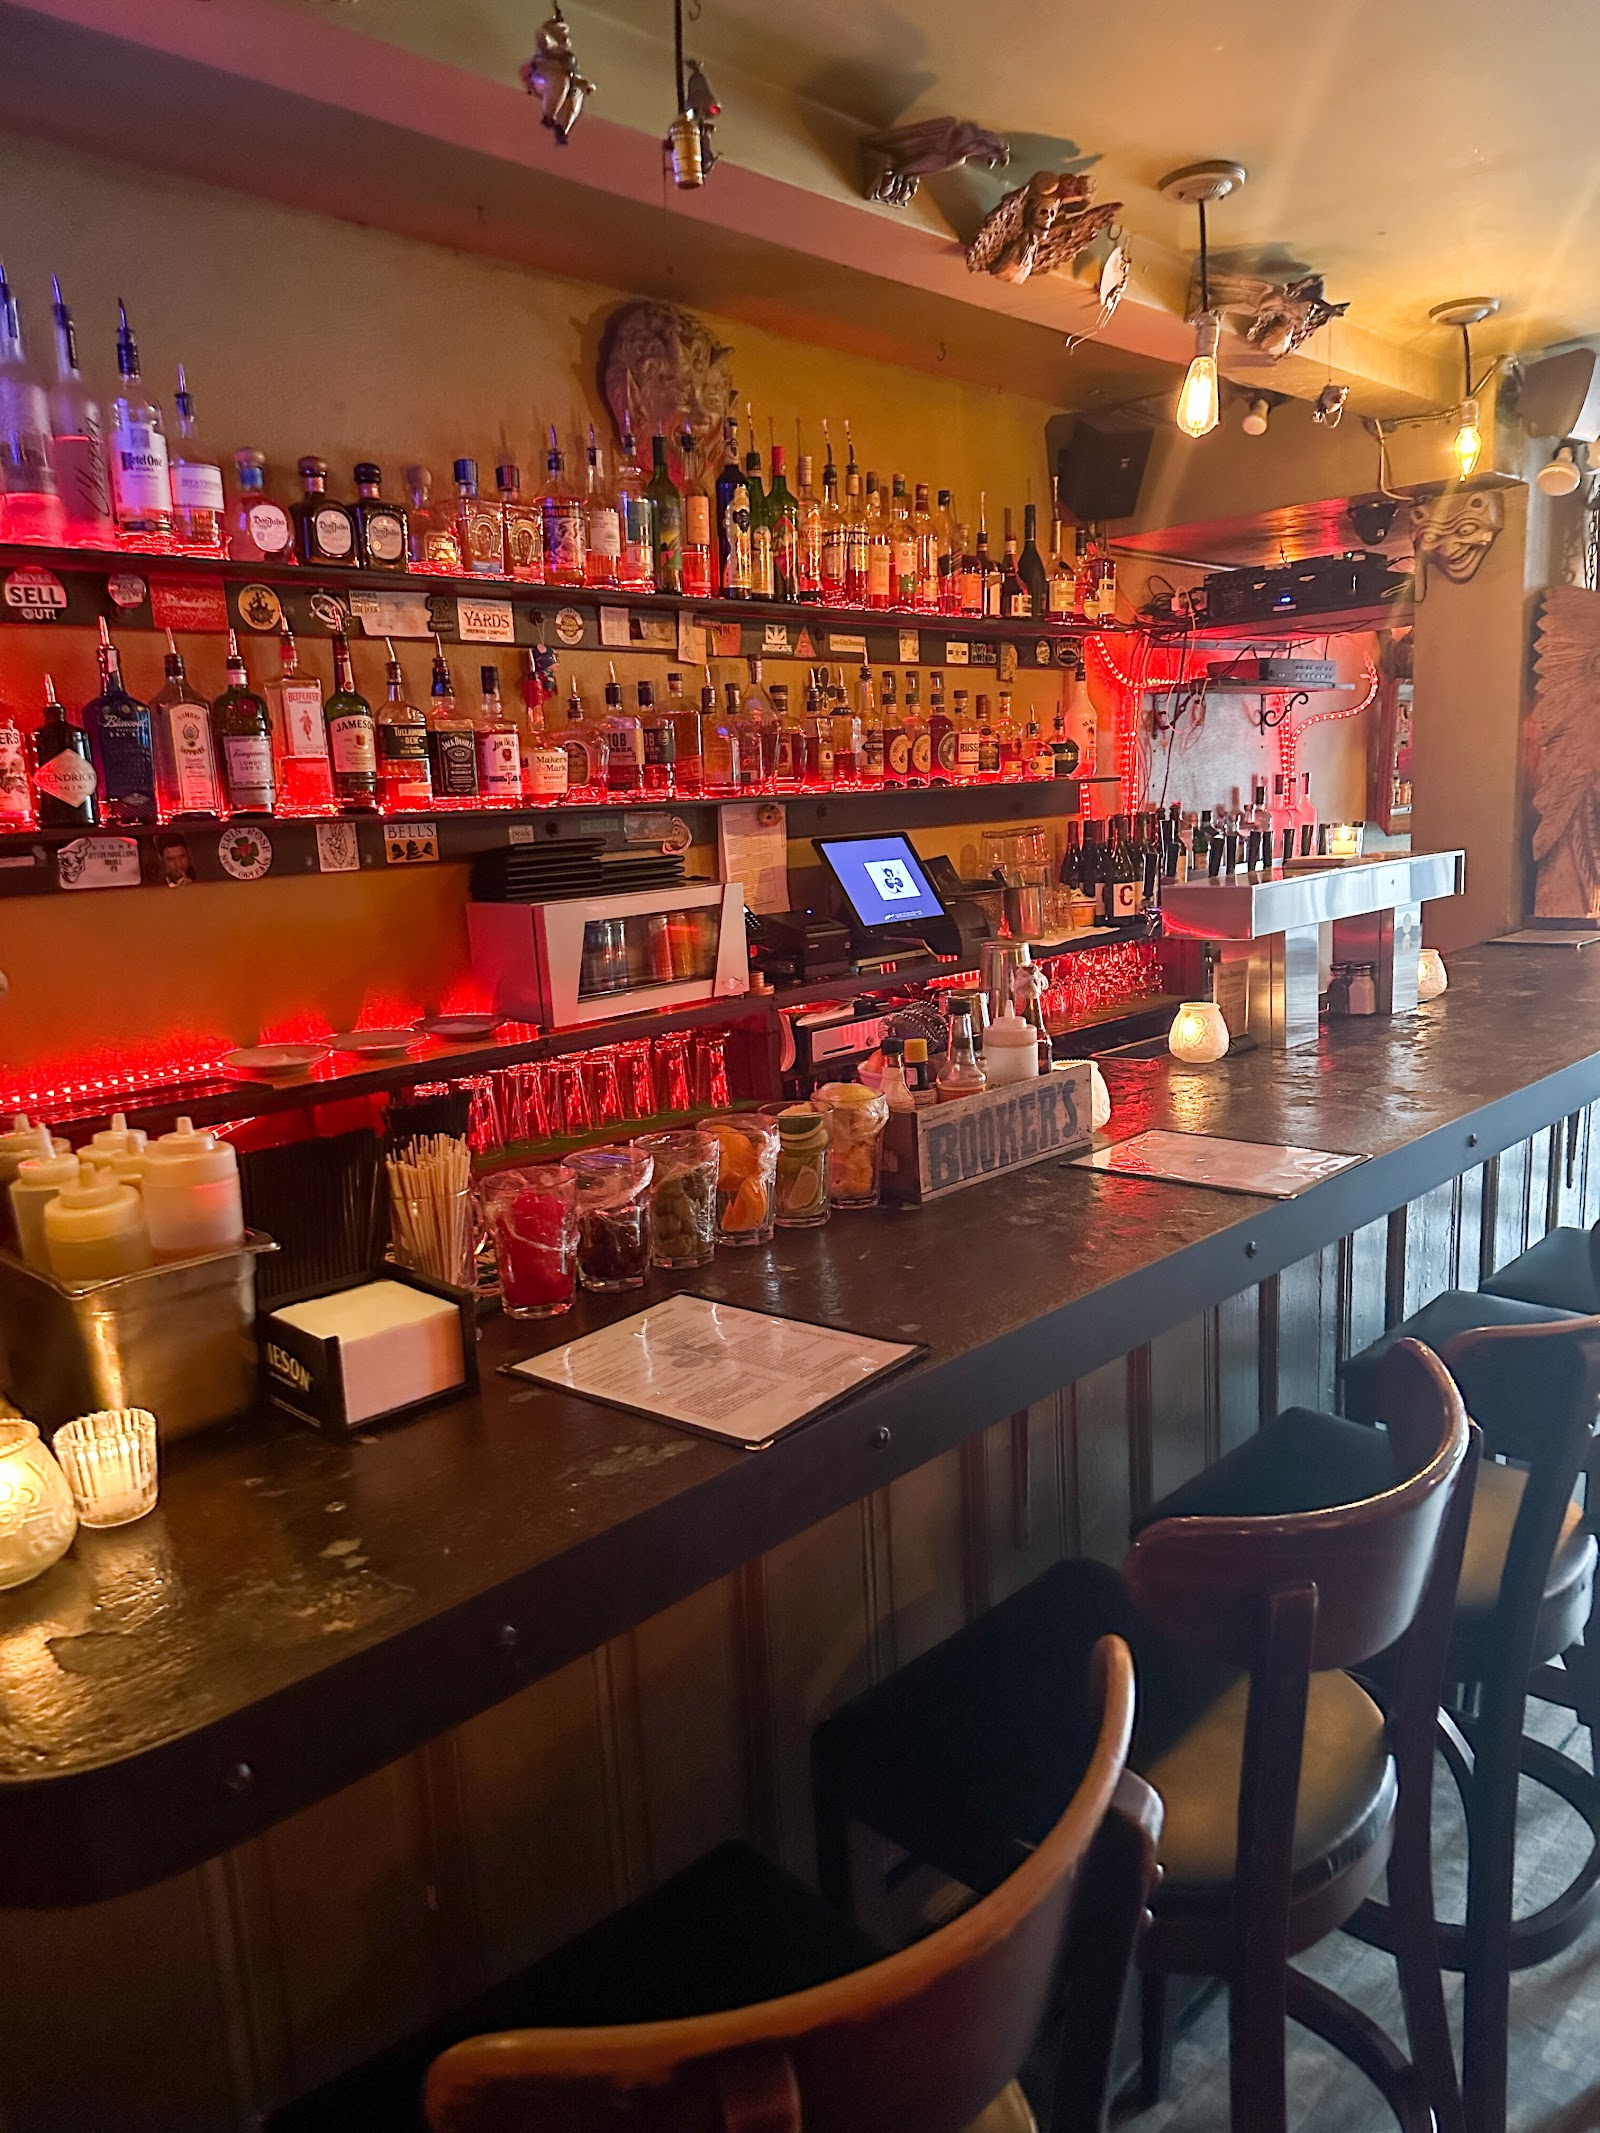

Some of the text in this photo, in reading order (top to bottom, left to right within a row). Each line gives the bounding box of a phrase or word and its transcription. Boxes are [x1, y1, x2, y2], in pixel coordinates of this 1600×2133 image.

[147, 454, 163, 467] One
[14, 571, 52, 583] NEVER
[10, 586, 62, 605] SELL
[22, 607, 57, 620] OUT!
[464, 611, 510, 629] YARDS
[762, 643, 793, 653] MEDICATE
[288, 691, 320, 702] BEEFEATER
[493, 740, 503, 752] JIM
[546, 764, 567, 772] Mark
[512, 828, 531, 838] peak
[220, 827, 271, 853] ERIN ROSE
[219, 854, 271, 880] NEW ORLEANS
[927, 1079, 1079, 1190] BOOKER'S
